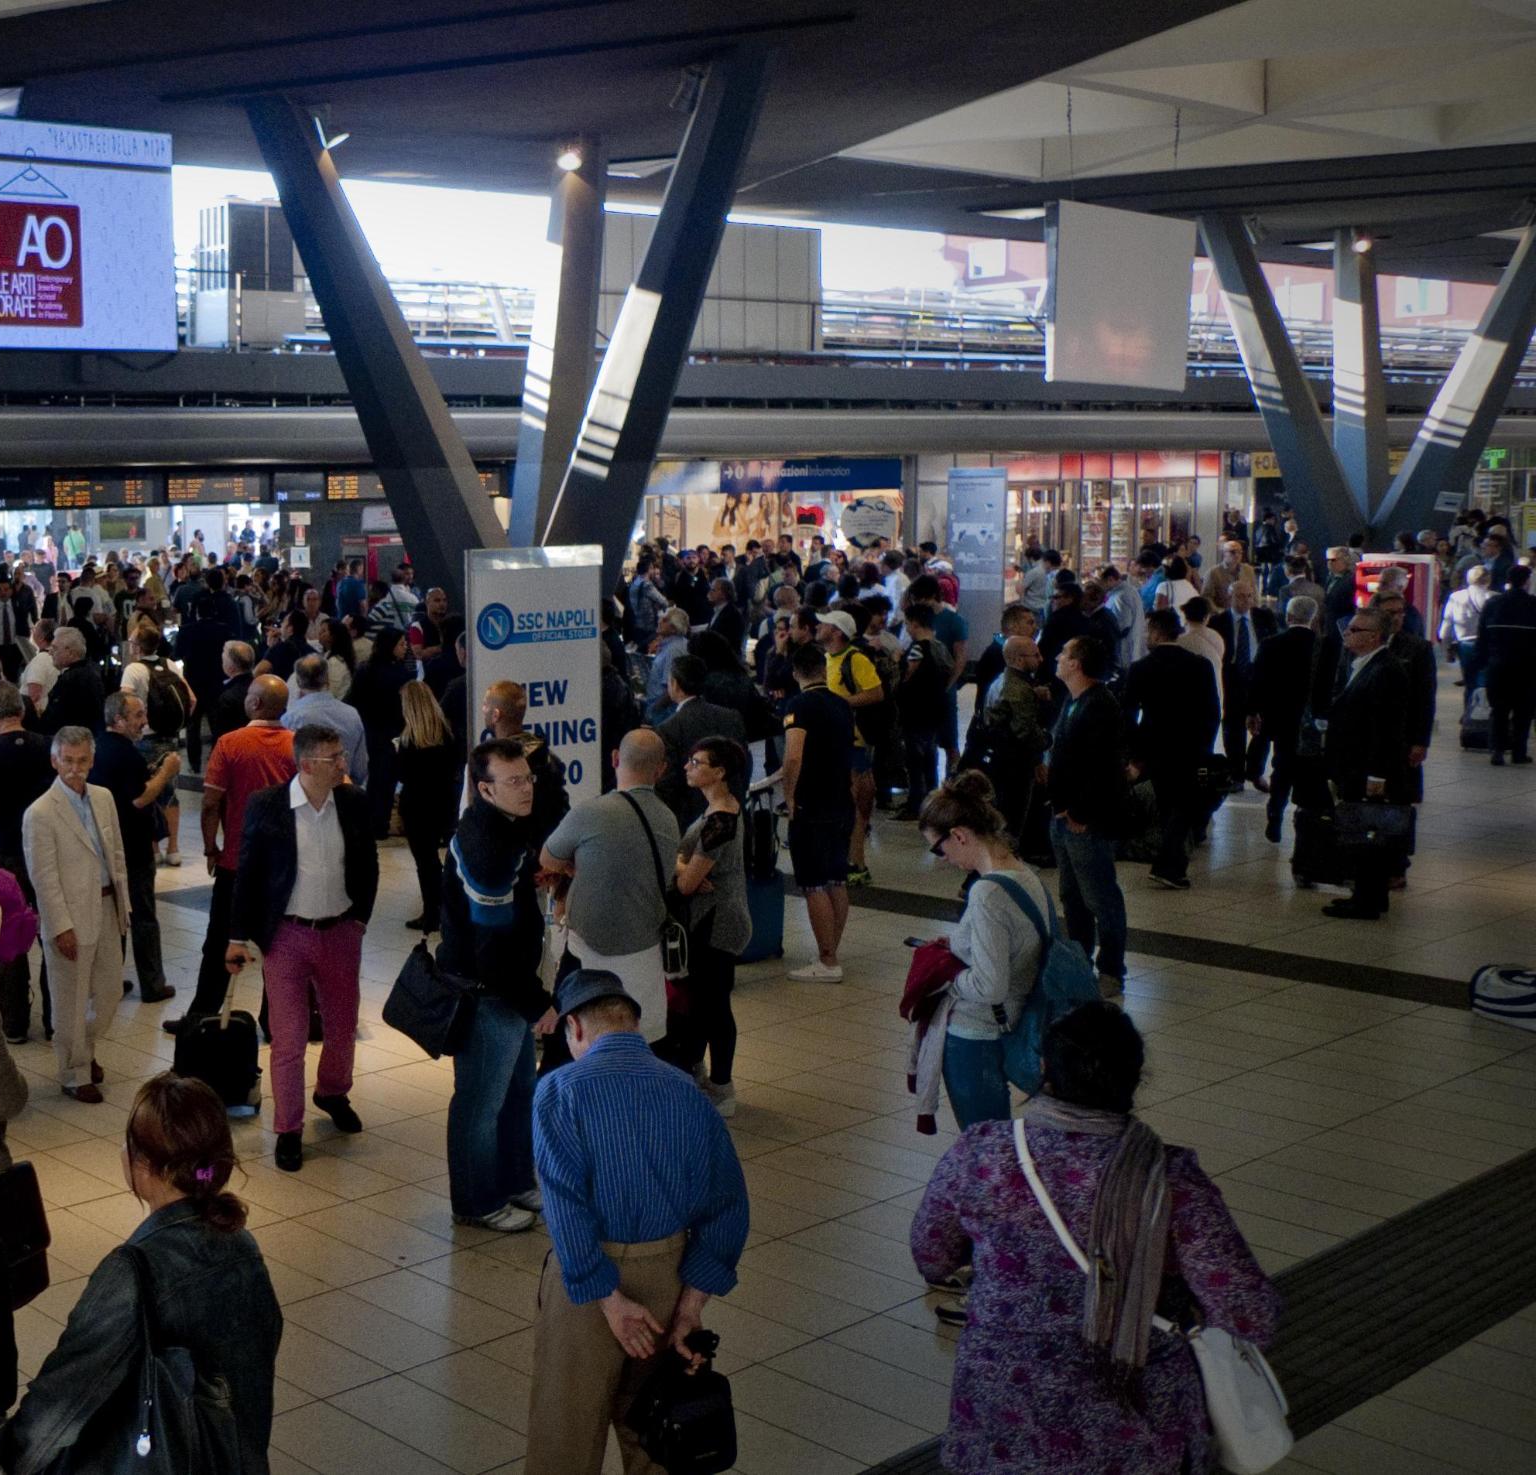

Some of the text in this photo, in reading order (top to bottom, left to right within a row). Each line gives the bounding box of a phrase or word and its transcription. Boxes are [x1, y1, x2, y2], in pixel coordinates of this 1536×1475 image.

[11, 272, 36, 295] ARTI
[487, 608, 595, 637] N SSC NAPOLI
[531, 629, 593, 642] OFFICIAL STORE
[521, 680, 568, 707] EW
